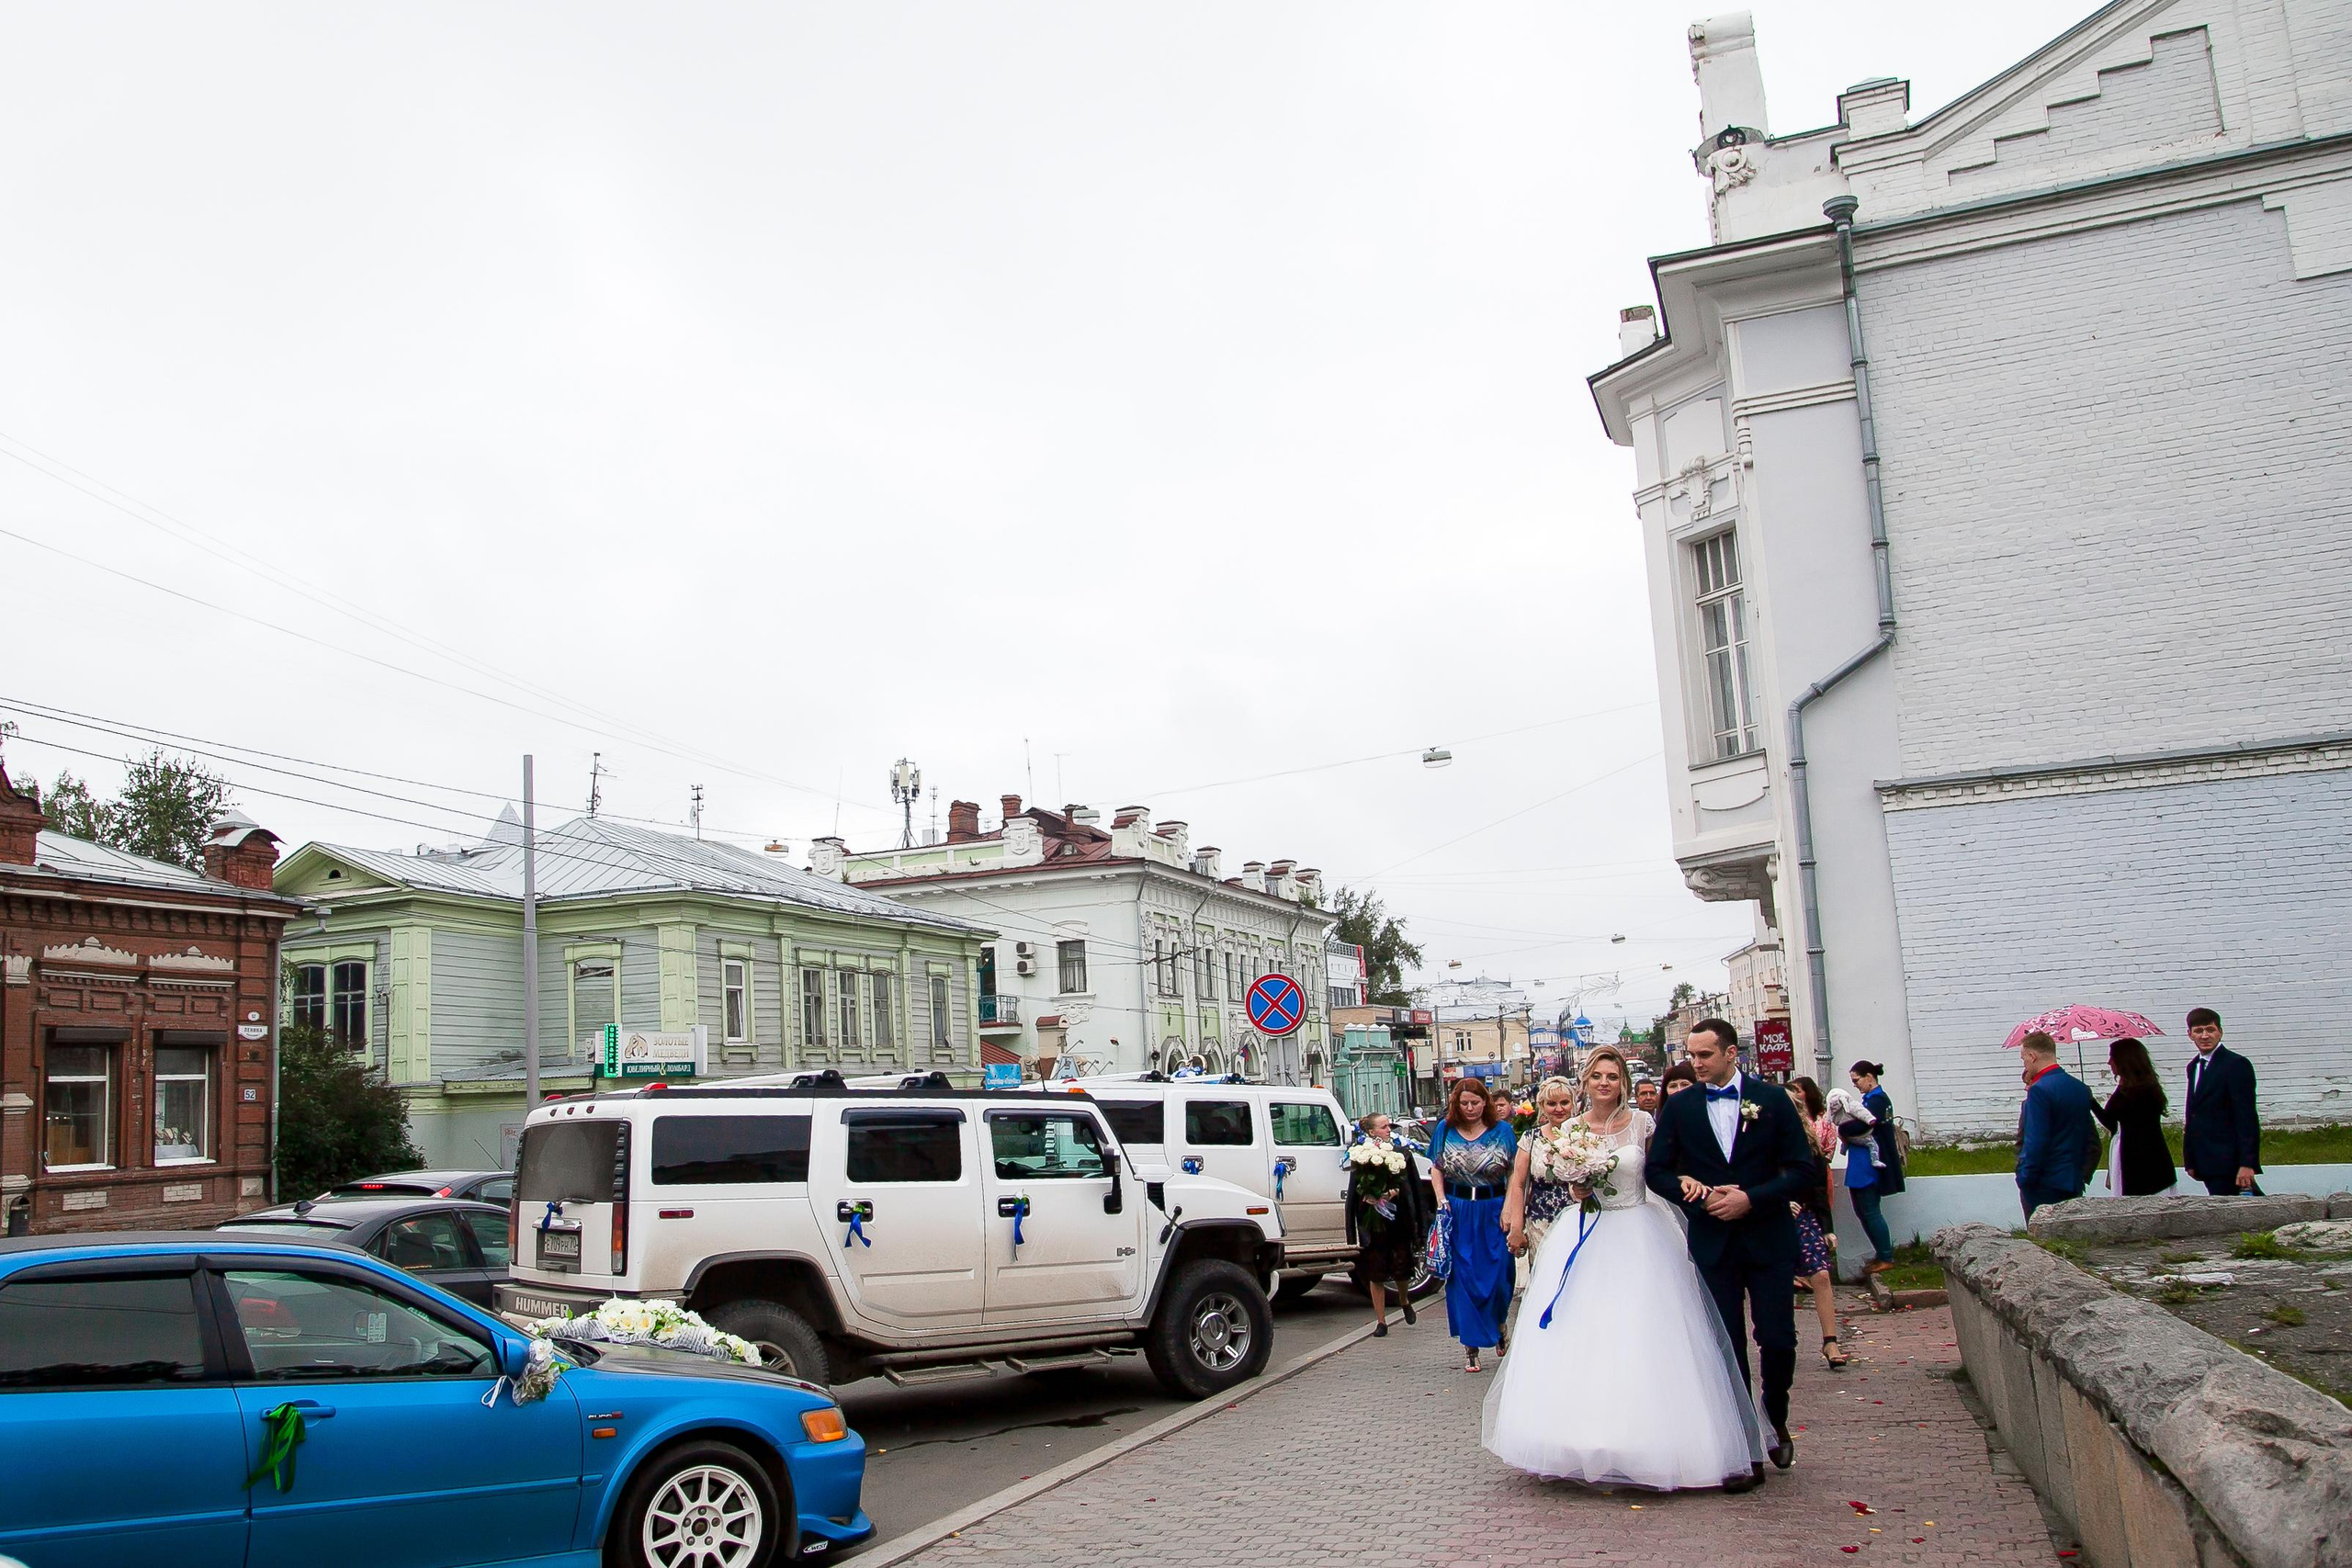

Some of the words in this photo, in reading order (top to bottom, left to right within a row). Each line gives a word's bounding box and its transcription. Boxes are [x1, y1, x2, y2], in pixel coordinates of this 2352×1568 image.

[653, 1036, 689, 1046] ЗОЛОТЫЕ
[1759, 1043, 1791, 1054] КАФЕ
[652, 1049, 689, 1059] МЕДВЕДИ
[627, 1065, 660, 1074] ЮВЕЛИРНЫЙ
[667, 1065, 691, 1073] ЛОМБАРД
[245, 1090, 255, 1100] 52
[515, 1296, 570, 1318] HUMMER
